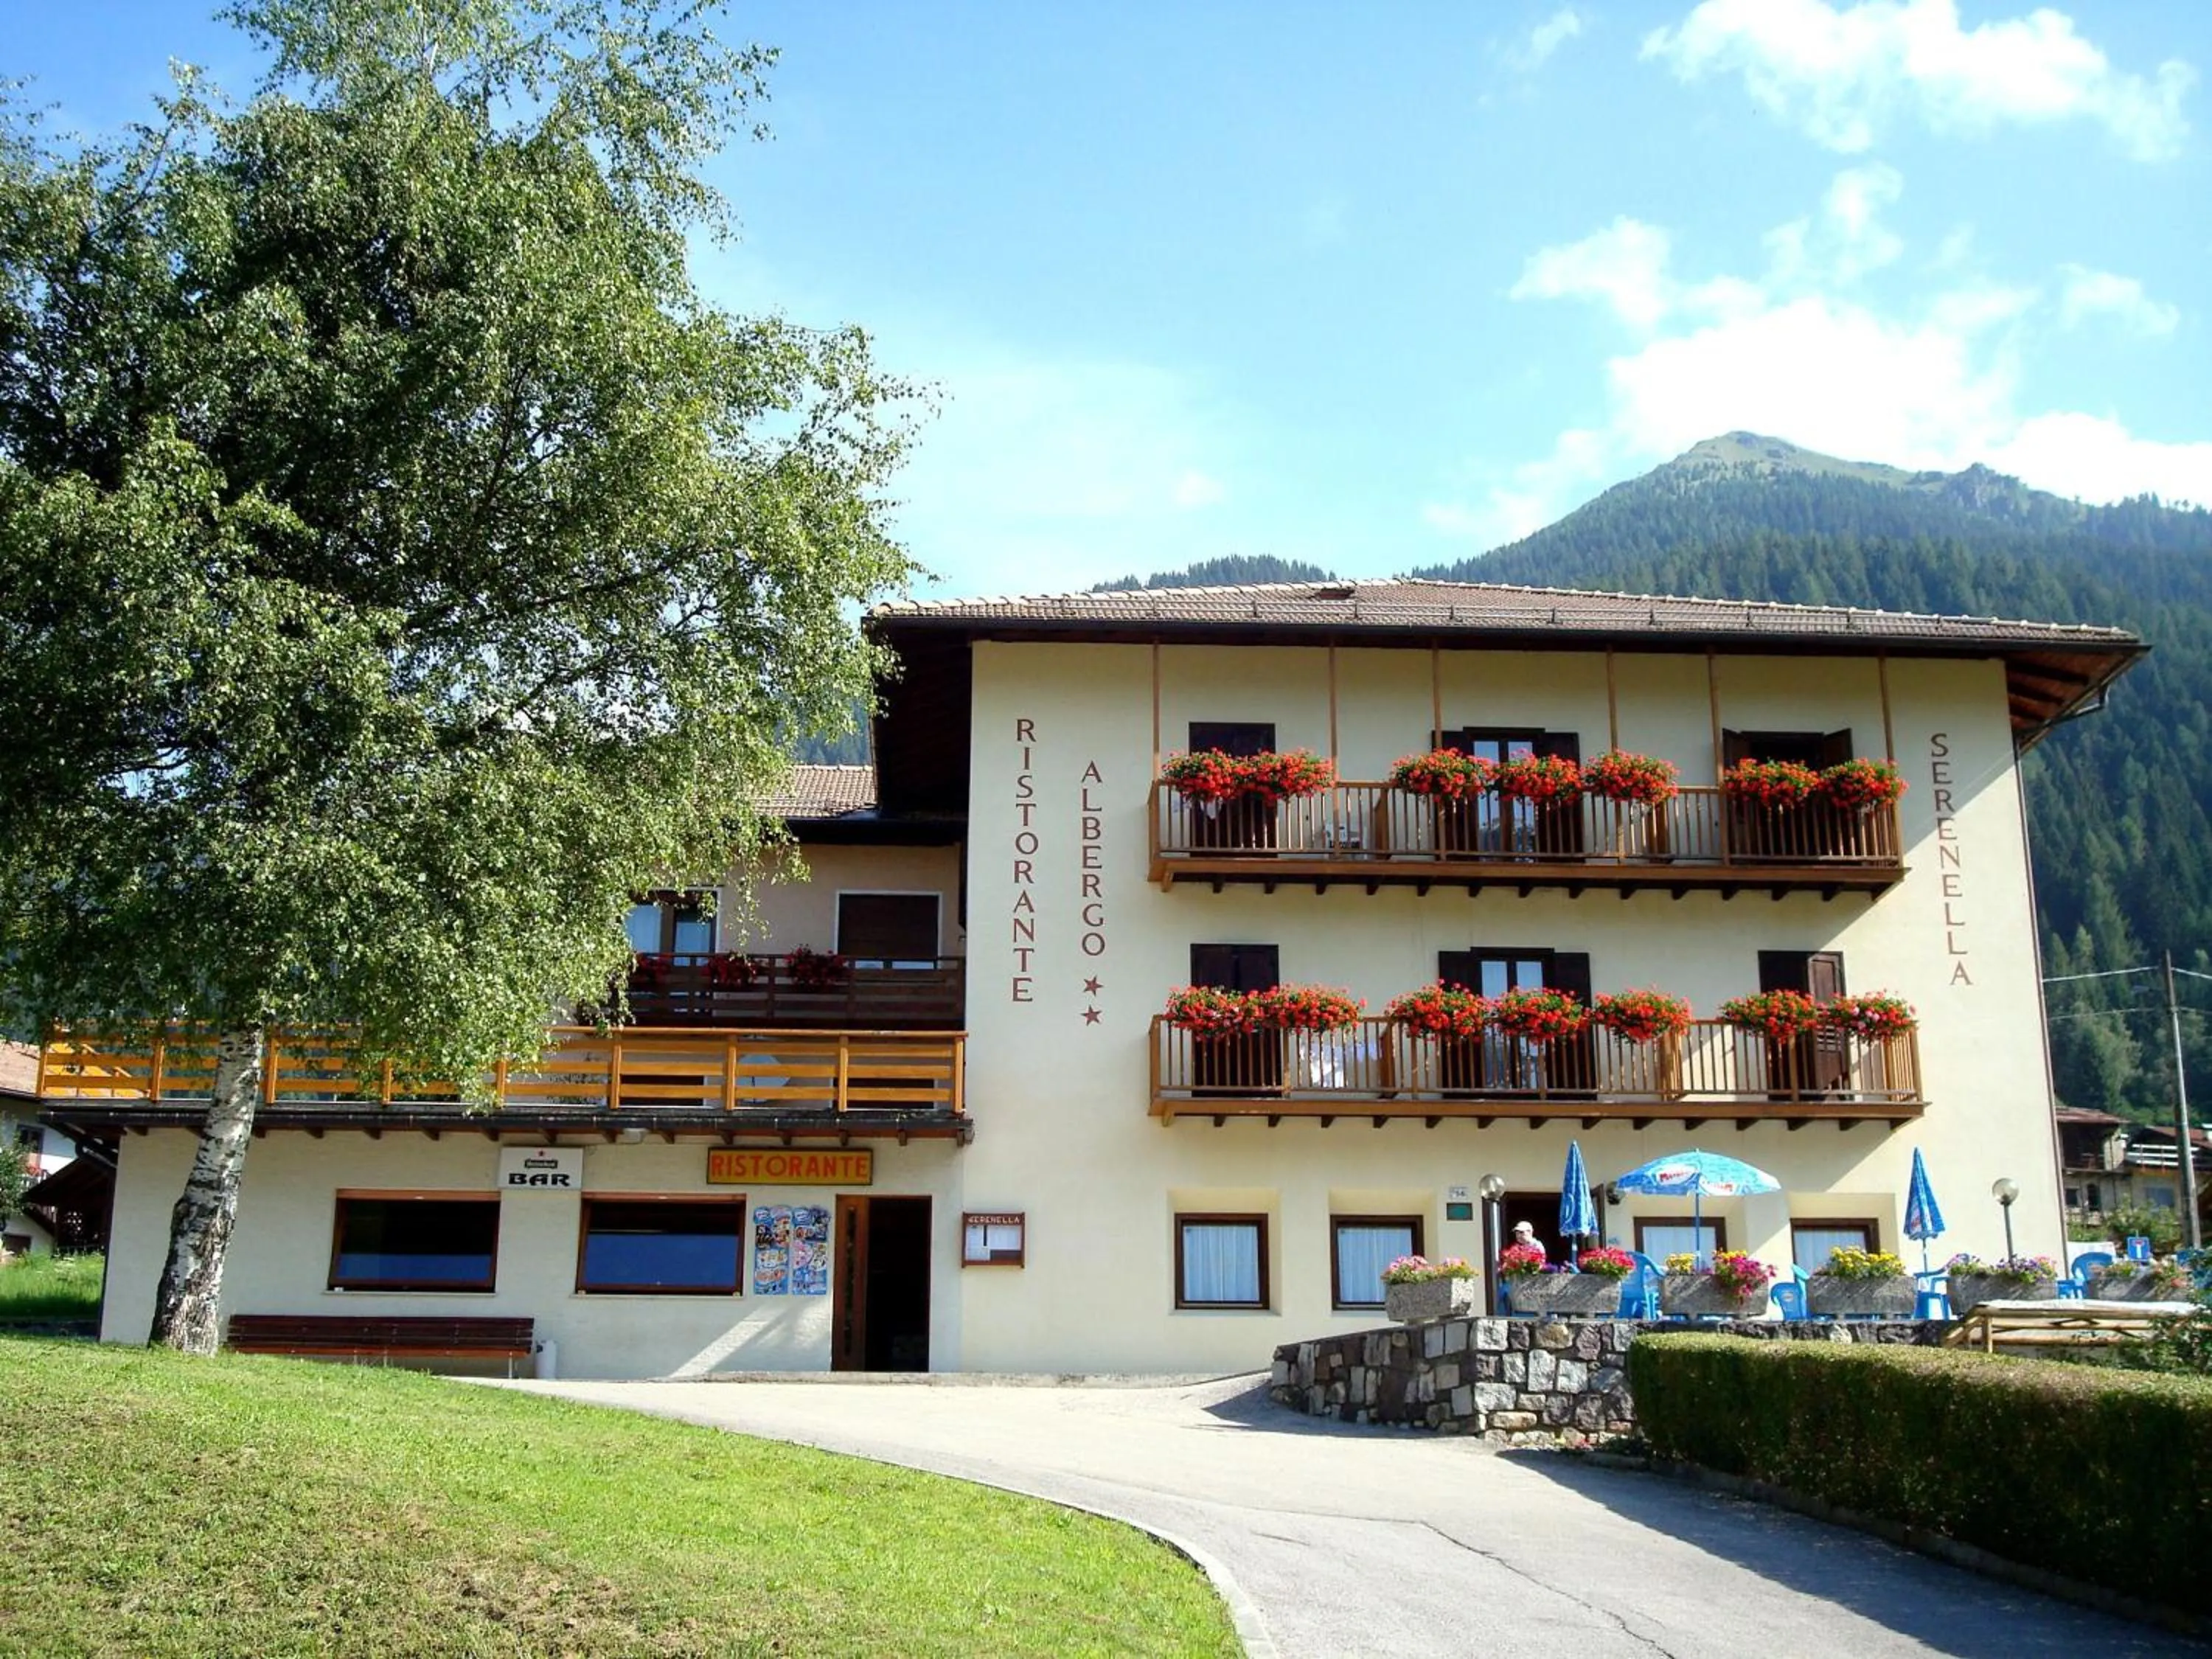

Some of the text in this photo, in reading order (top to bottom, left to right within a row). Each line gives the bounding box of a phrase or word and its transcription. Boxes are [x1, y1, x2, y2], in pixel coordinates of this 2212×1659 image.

[1012, 718, 1039, 1003] RISTORANTE
[1081, 760, 1106, 956] ALBERGO
[1930, 733, 1973, 985] SERENELLA
[508, 1172, 571, 1187] BAR
[711, 1153, 869, 1178] RISTORANTE
